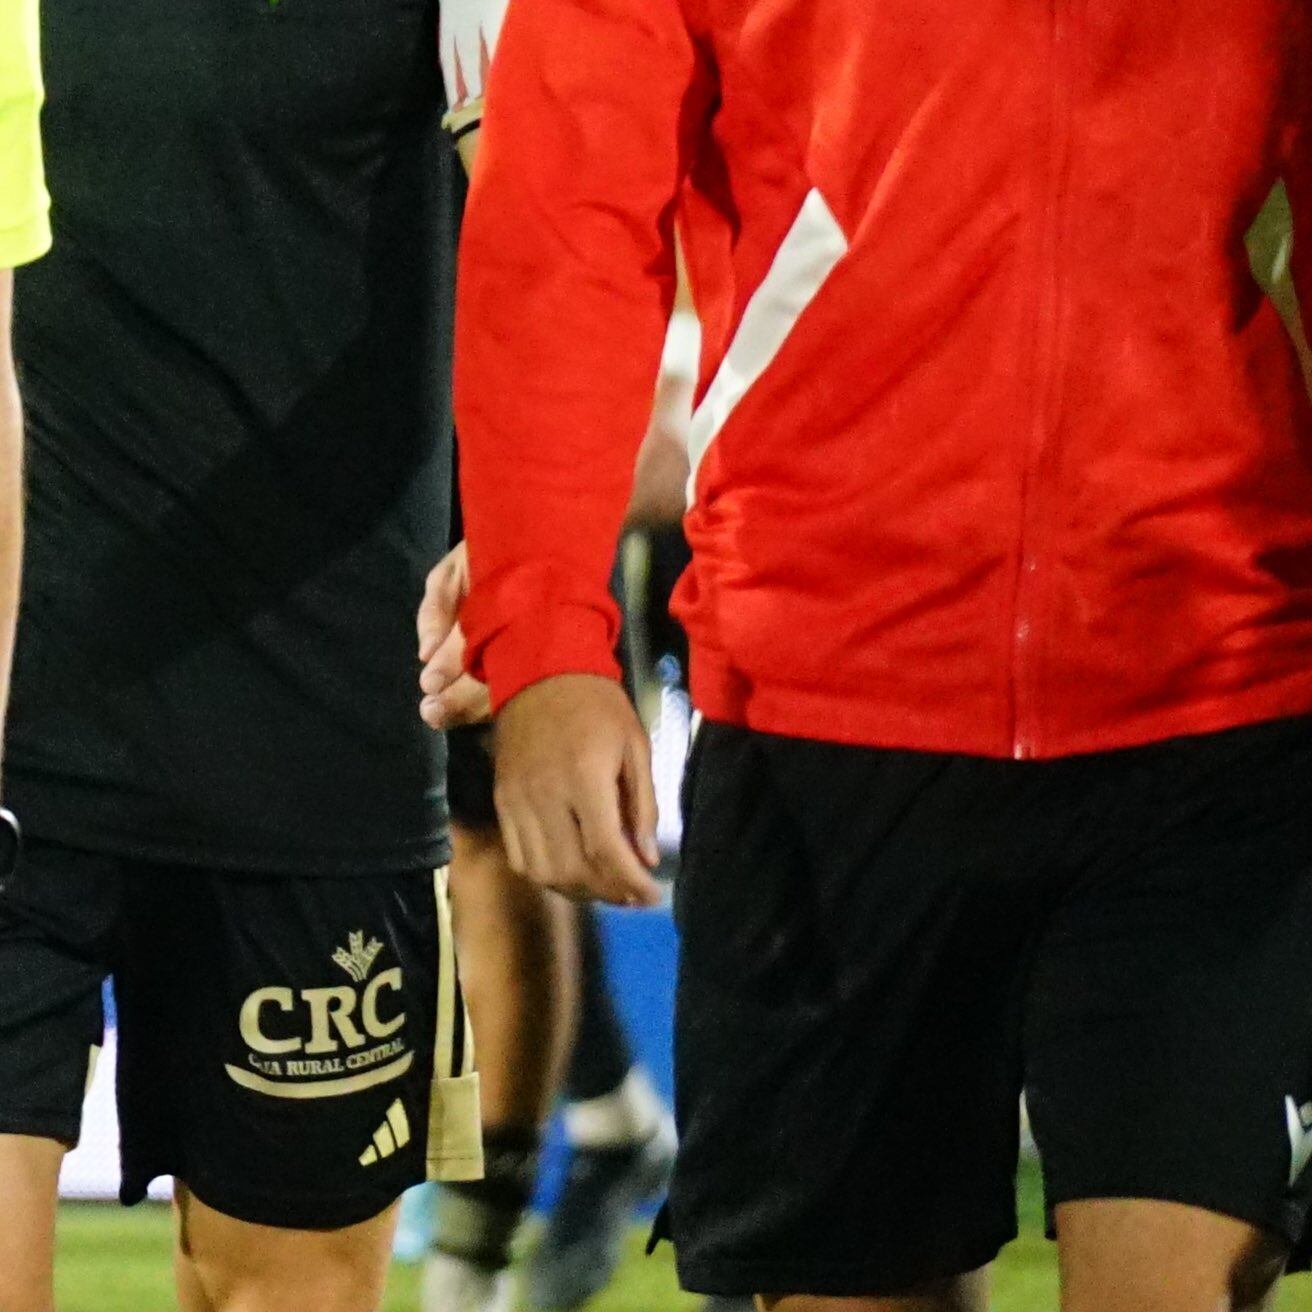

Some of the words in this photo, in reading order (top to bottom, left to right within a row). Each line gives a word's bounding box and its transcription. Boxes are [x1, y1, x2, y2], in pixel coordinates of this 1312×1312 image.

[239, 967, 406, 1055] CRC
[286, 1057, 345, 1076] RURAL
[345, 1038, 406, 1069] CENTRAL
